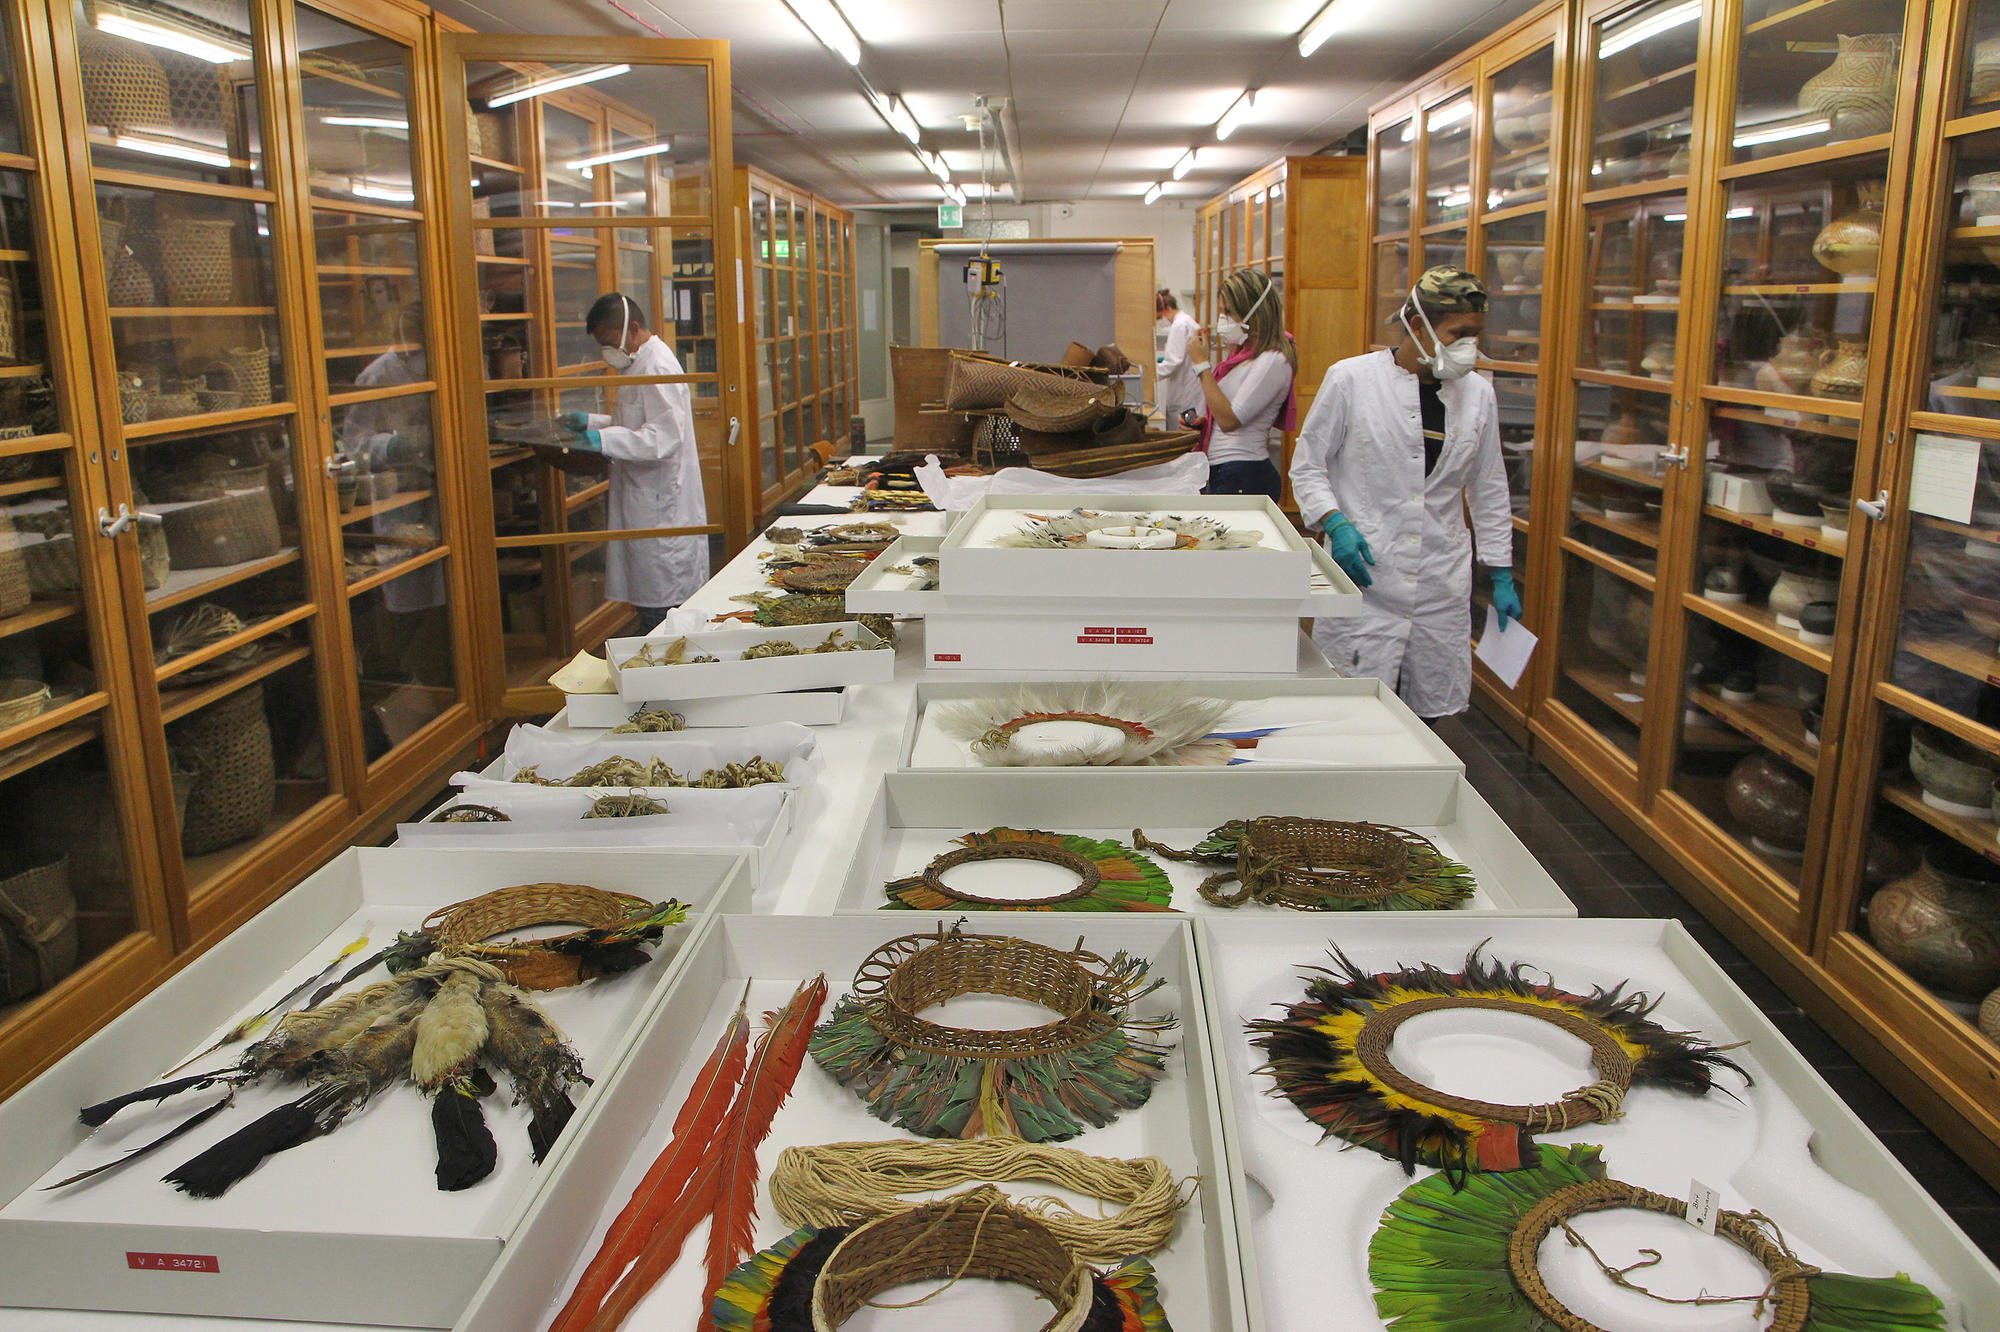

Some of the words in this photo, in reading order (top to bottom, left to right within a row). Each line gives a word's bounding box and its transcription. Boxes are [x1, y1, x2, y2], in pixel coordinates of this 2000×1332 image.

[137, 1257, 145, 1265] V
[157, 1258, 165, 1266] A
[172, 1258, 207, 1269] 34721
